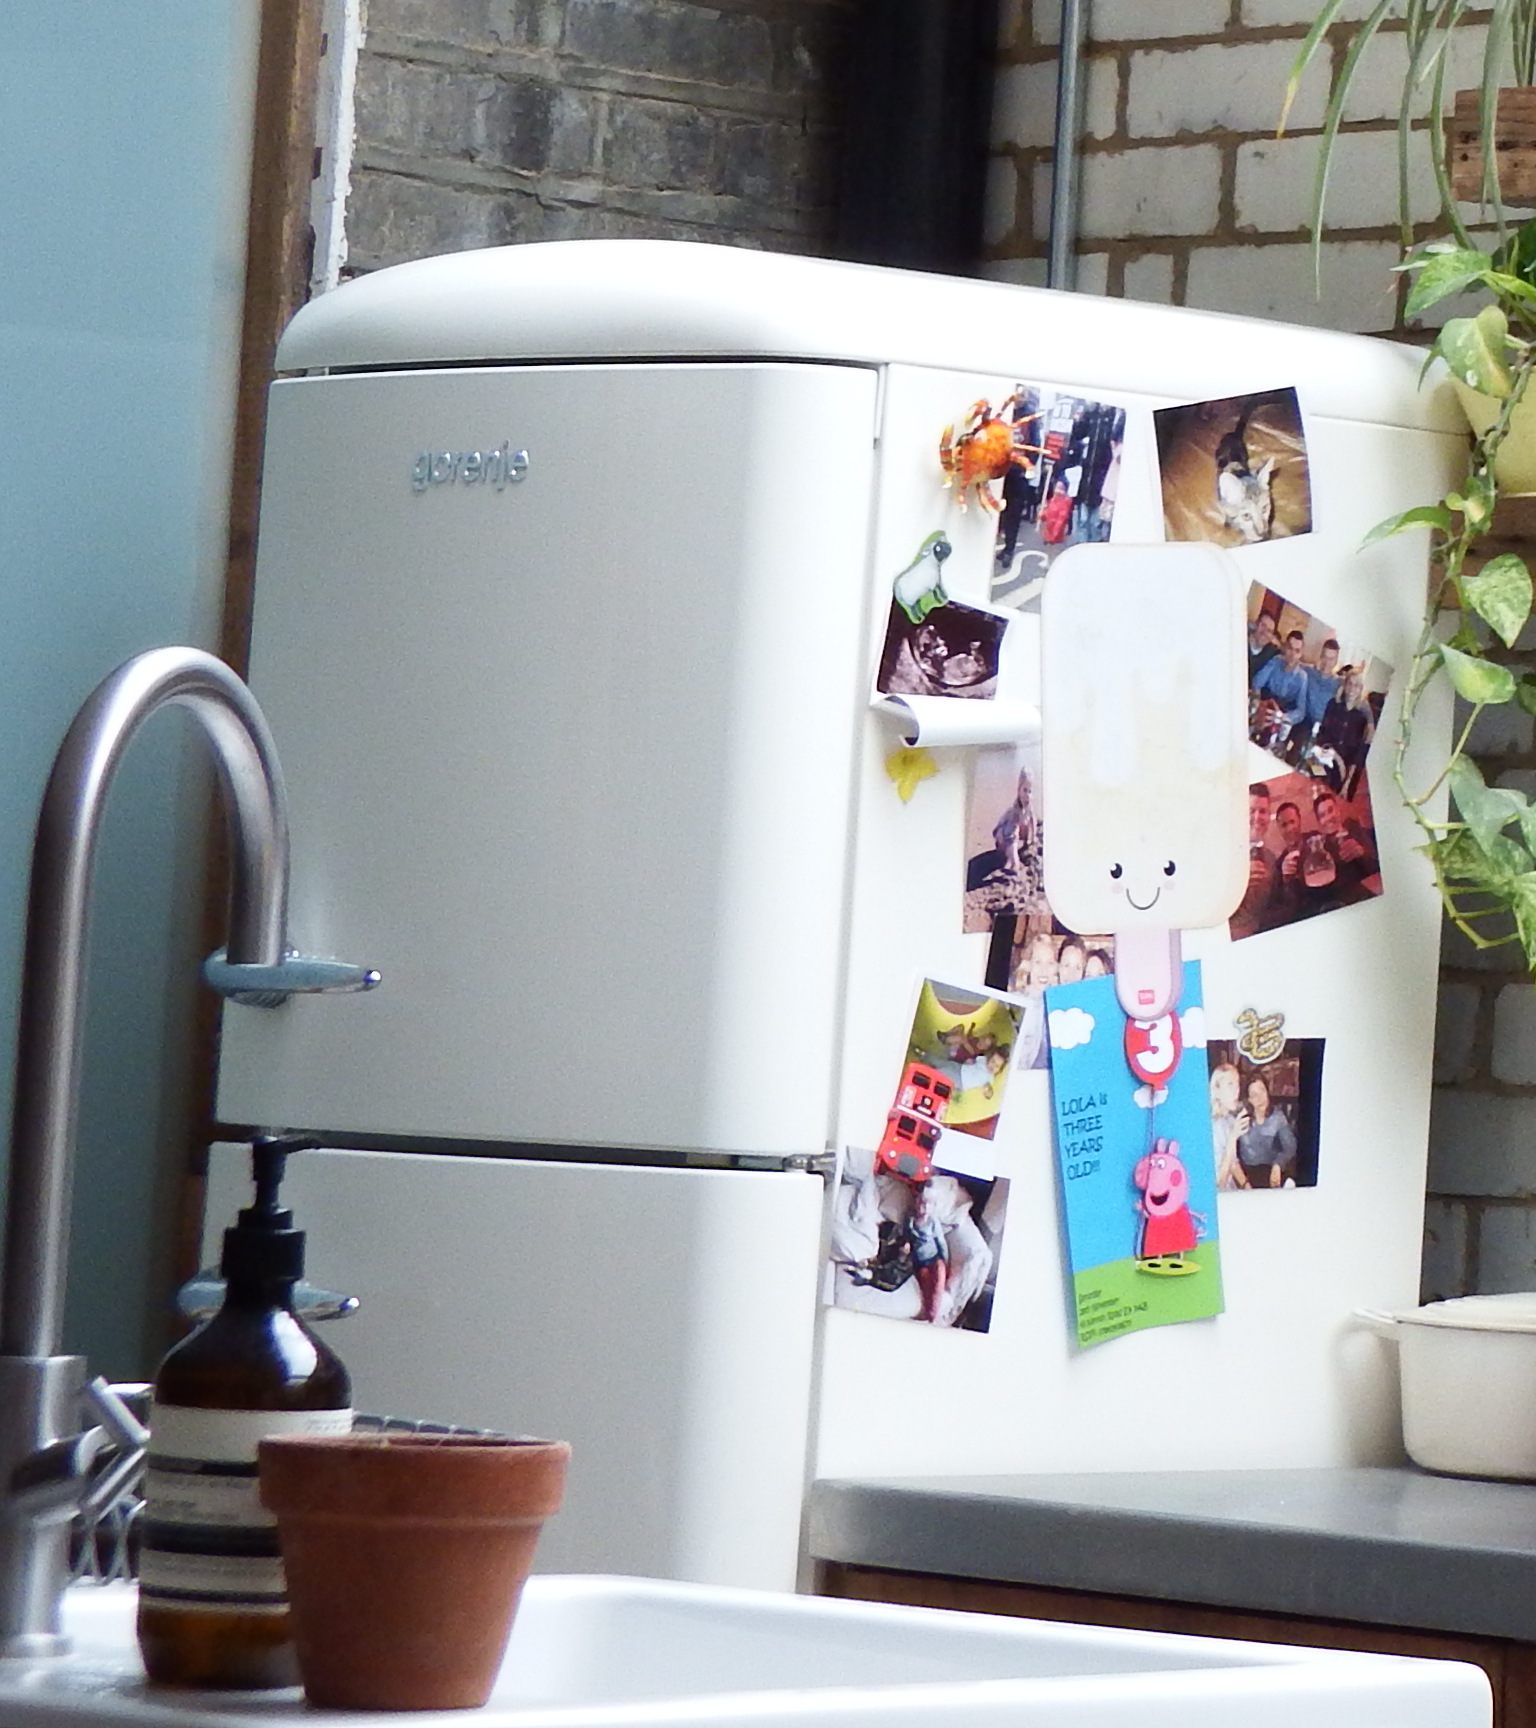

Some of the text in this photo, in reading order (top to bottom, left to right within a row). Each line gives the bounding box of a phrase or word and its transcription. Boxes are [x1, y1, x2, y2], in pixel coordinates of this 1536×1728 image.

[411, 439, 530, 492] gorenje
[1134, 1015, 1175, 1074] 3
[1061, 1095, 1096, 1117] LOLA
[1063, 1114, 1104, 1137] THREE
[1064, 1135, 1104, 1159] YEARS
